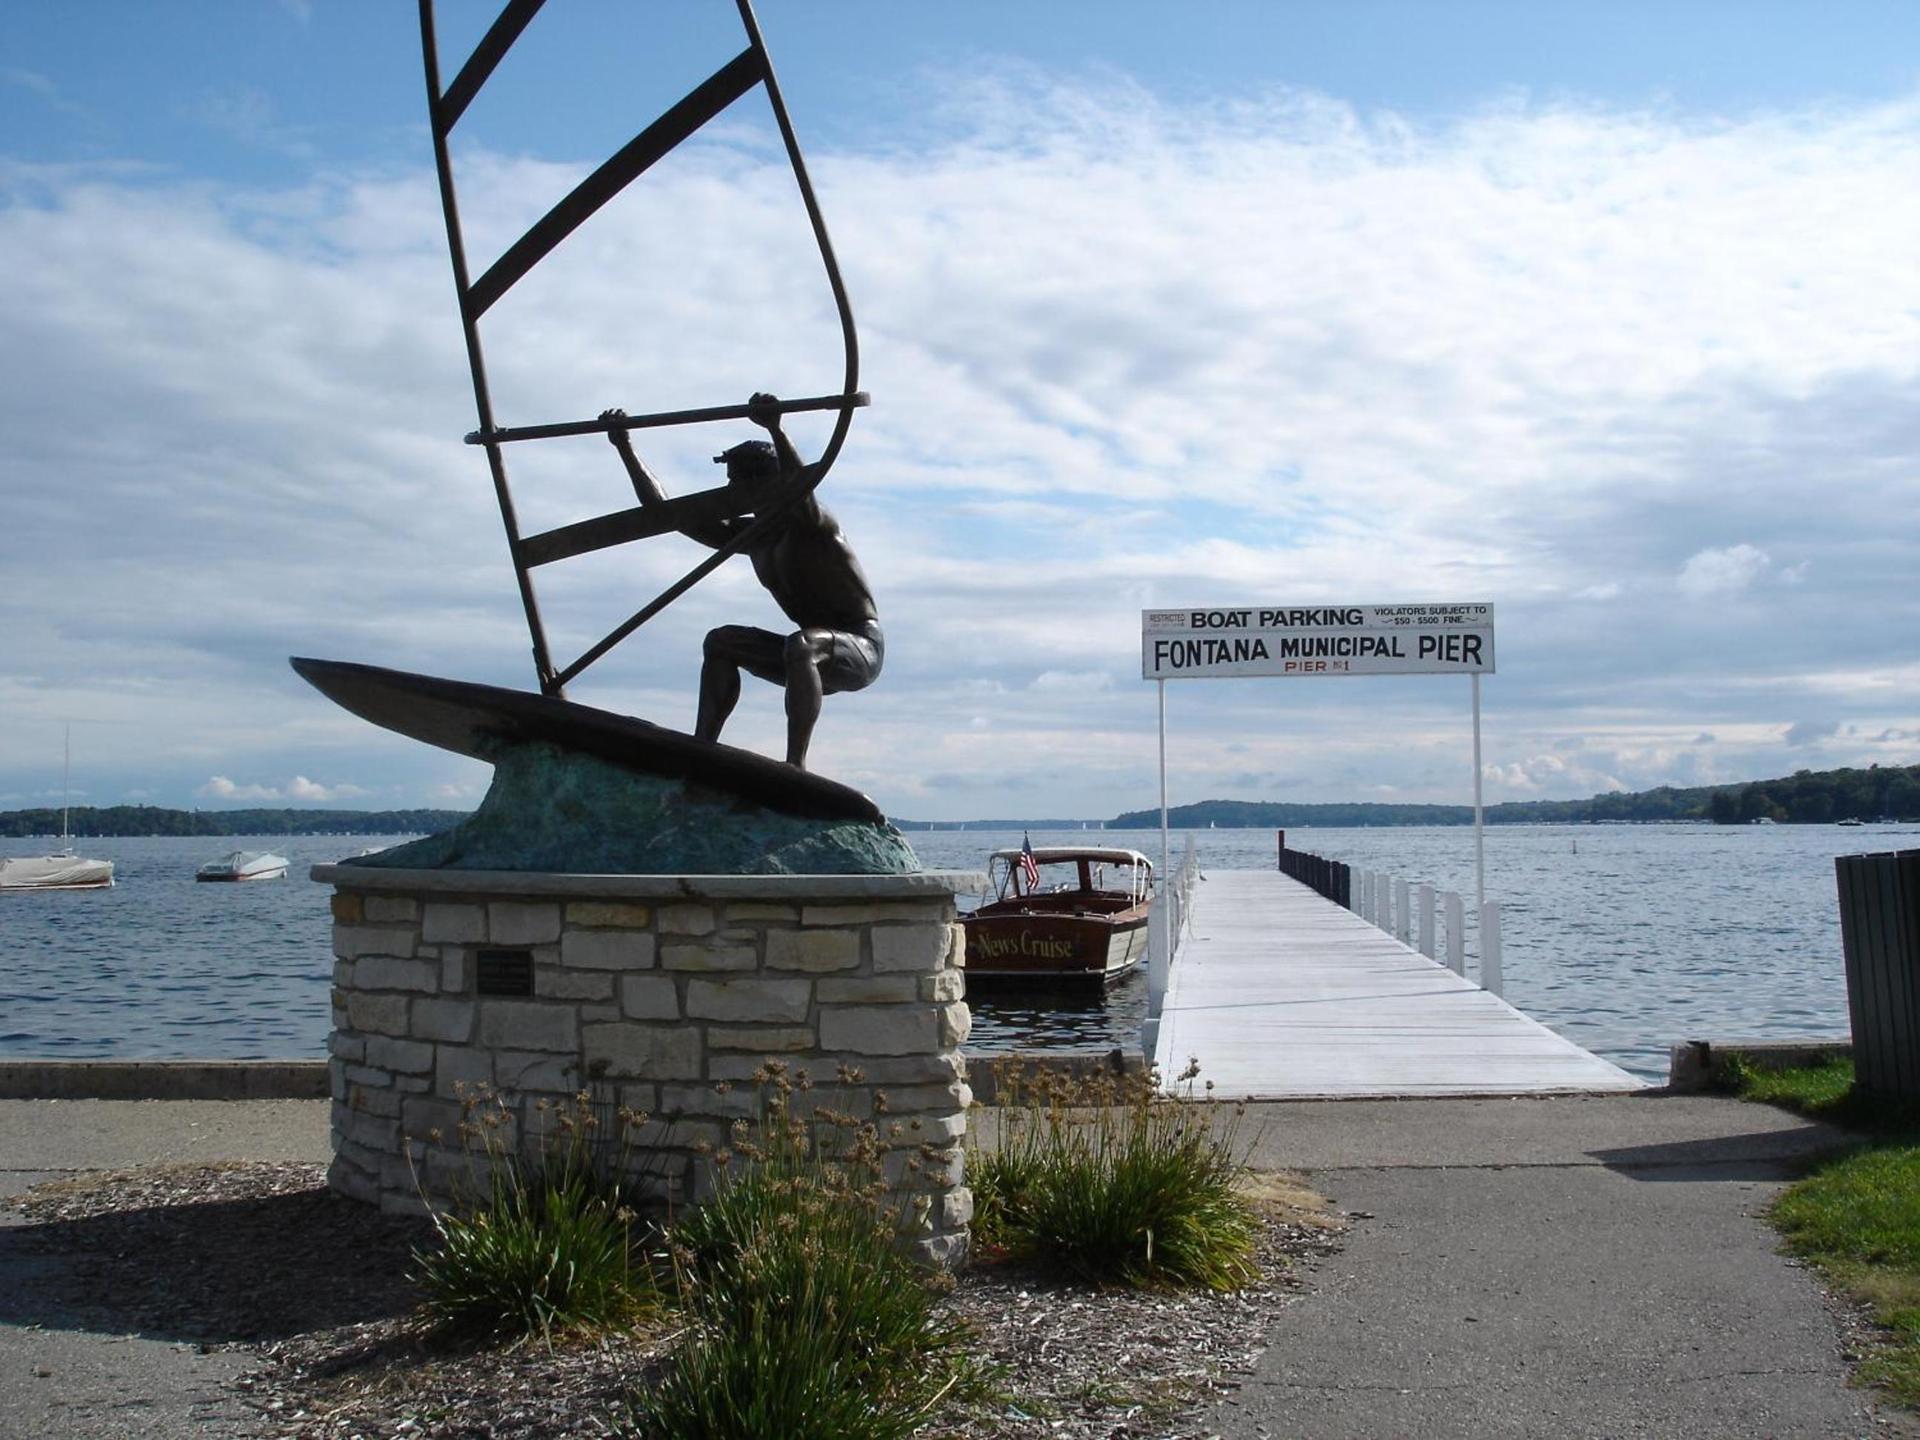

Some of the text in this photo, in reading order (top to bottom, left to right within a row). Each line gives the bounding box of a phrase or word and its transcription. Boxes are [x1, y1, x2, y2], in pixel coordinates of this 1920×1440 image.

[1191, 608, 1364, 628] BOAT PARKING
[1374, 605, 1487, 616] VIOLATORS SUBJECT TO
[1394, 617, 1410, 625] $50
[1418, 616, 1438, 625] $500
[1154, 634, 1482, 671] FONTANA MUNICIPAL PIER
[1285, 660, 1327, 672] PIER
[1021, 929, 1072, 958] Cruise
